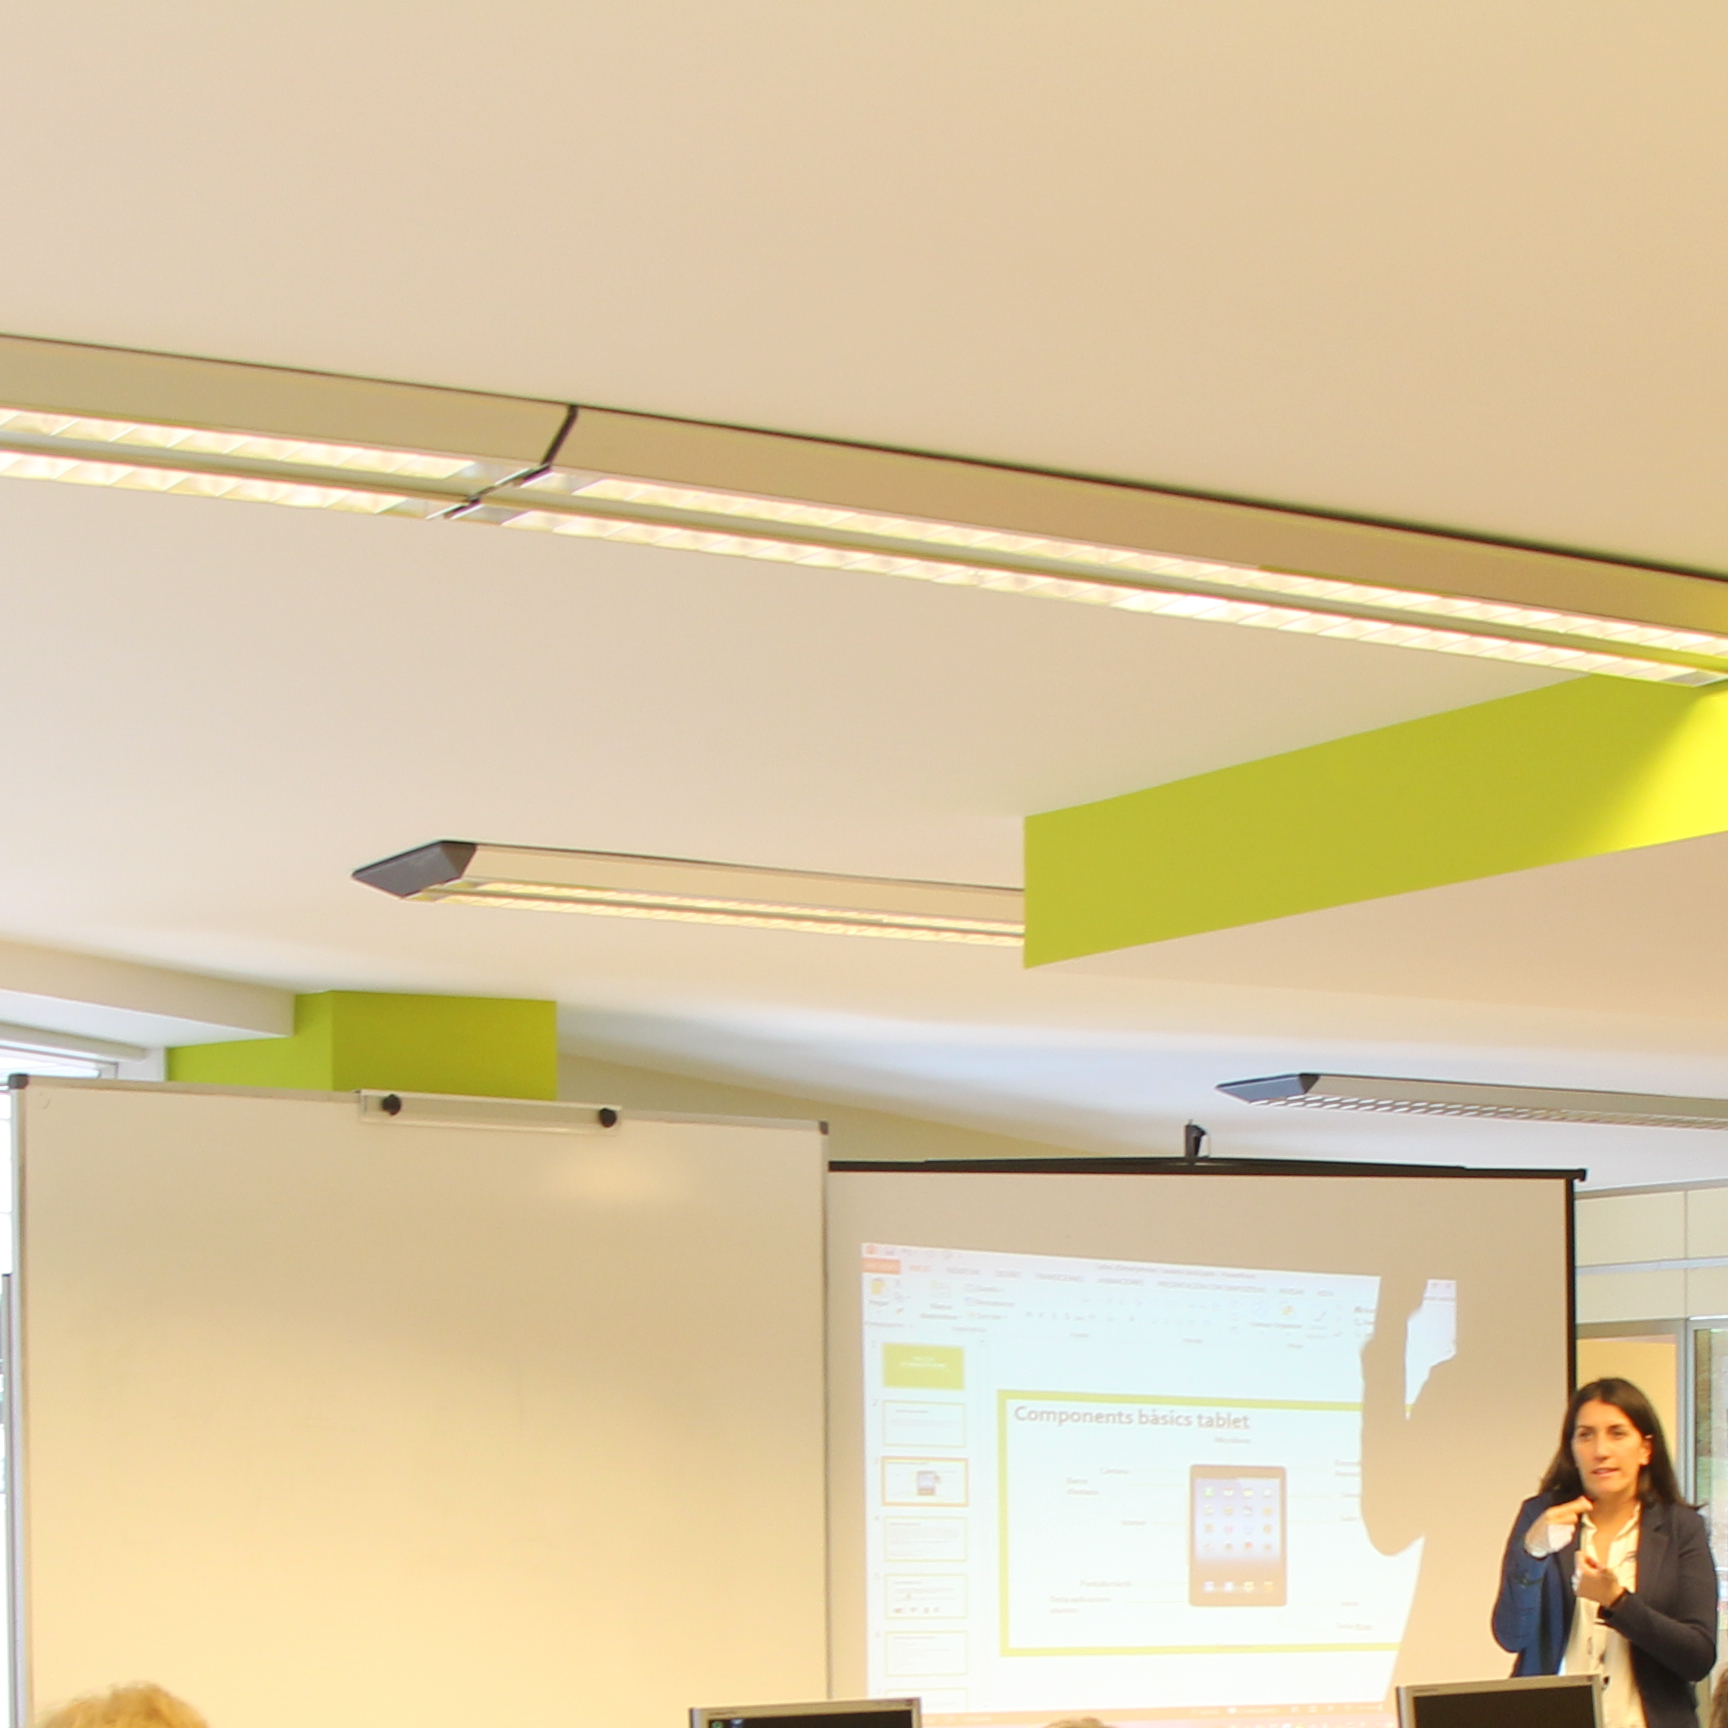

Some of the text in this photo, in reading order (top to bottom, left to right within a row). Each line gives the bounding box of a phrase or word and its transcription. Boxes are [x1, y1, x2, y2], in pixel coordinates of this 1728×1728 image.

[1015, 1407, 1250, 1429] Components bàsics tablet
